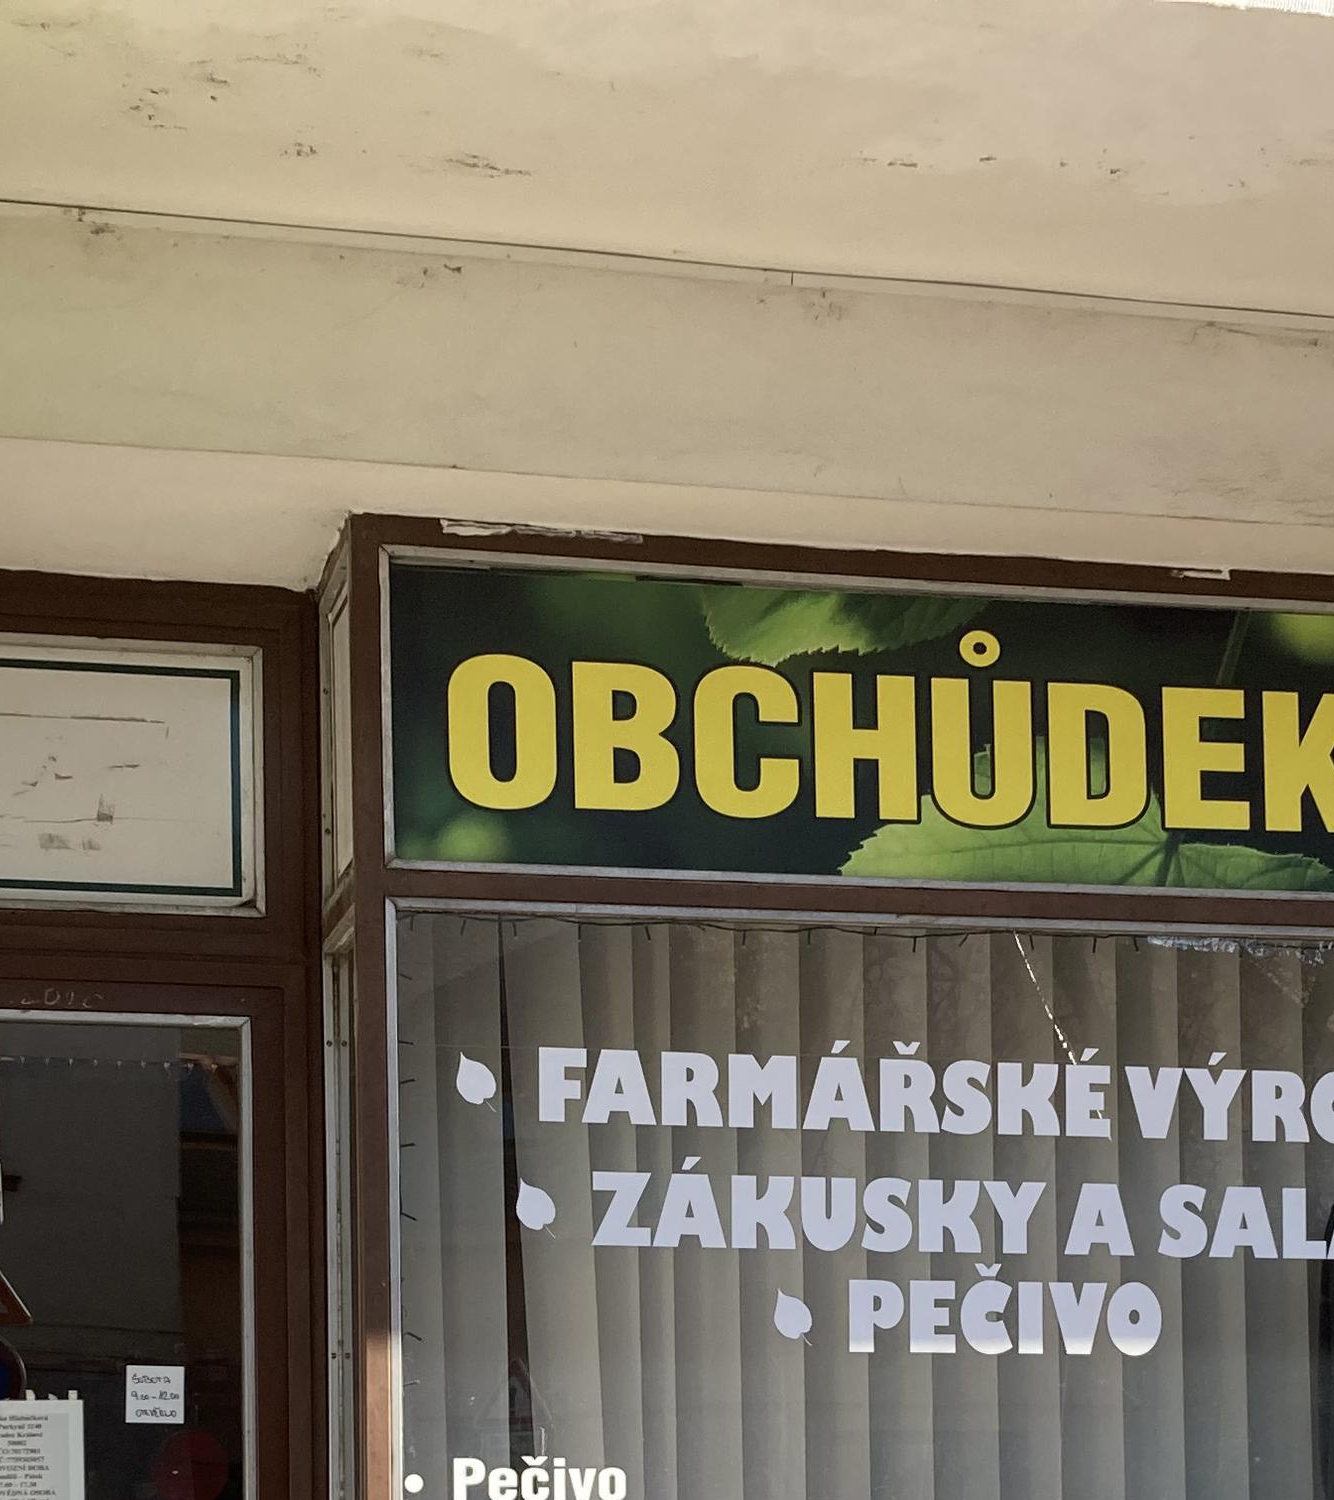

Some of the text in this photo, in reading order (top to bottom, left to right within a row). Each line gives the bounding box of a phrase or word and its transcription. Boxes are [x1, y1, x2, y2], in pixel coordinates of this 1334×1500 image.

[537, 1039, 1113, 1141] FARMÁŘSKÉ
[590, 1155, 1047, 1256] ZÁKUSKY
[1064, 1181, 1135, 1258] A
[848, 1262, 1163, 1358] PEČIVO
